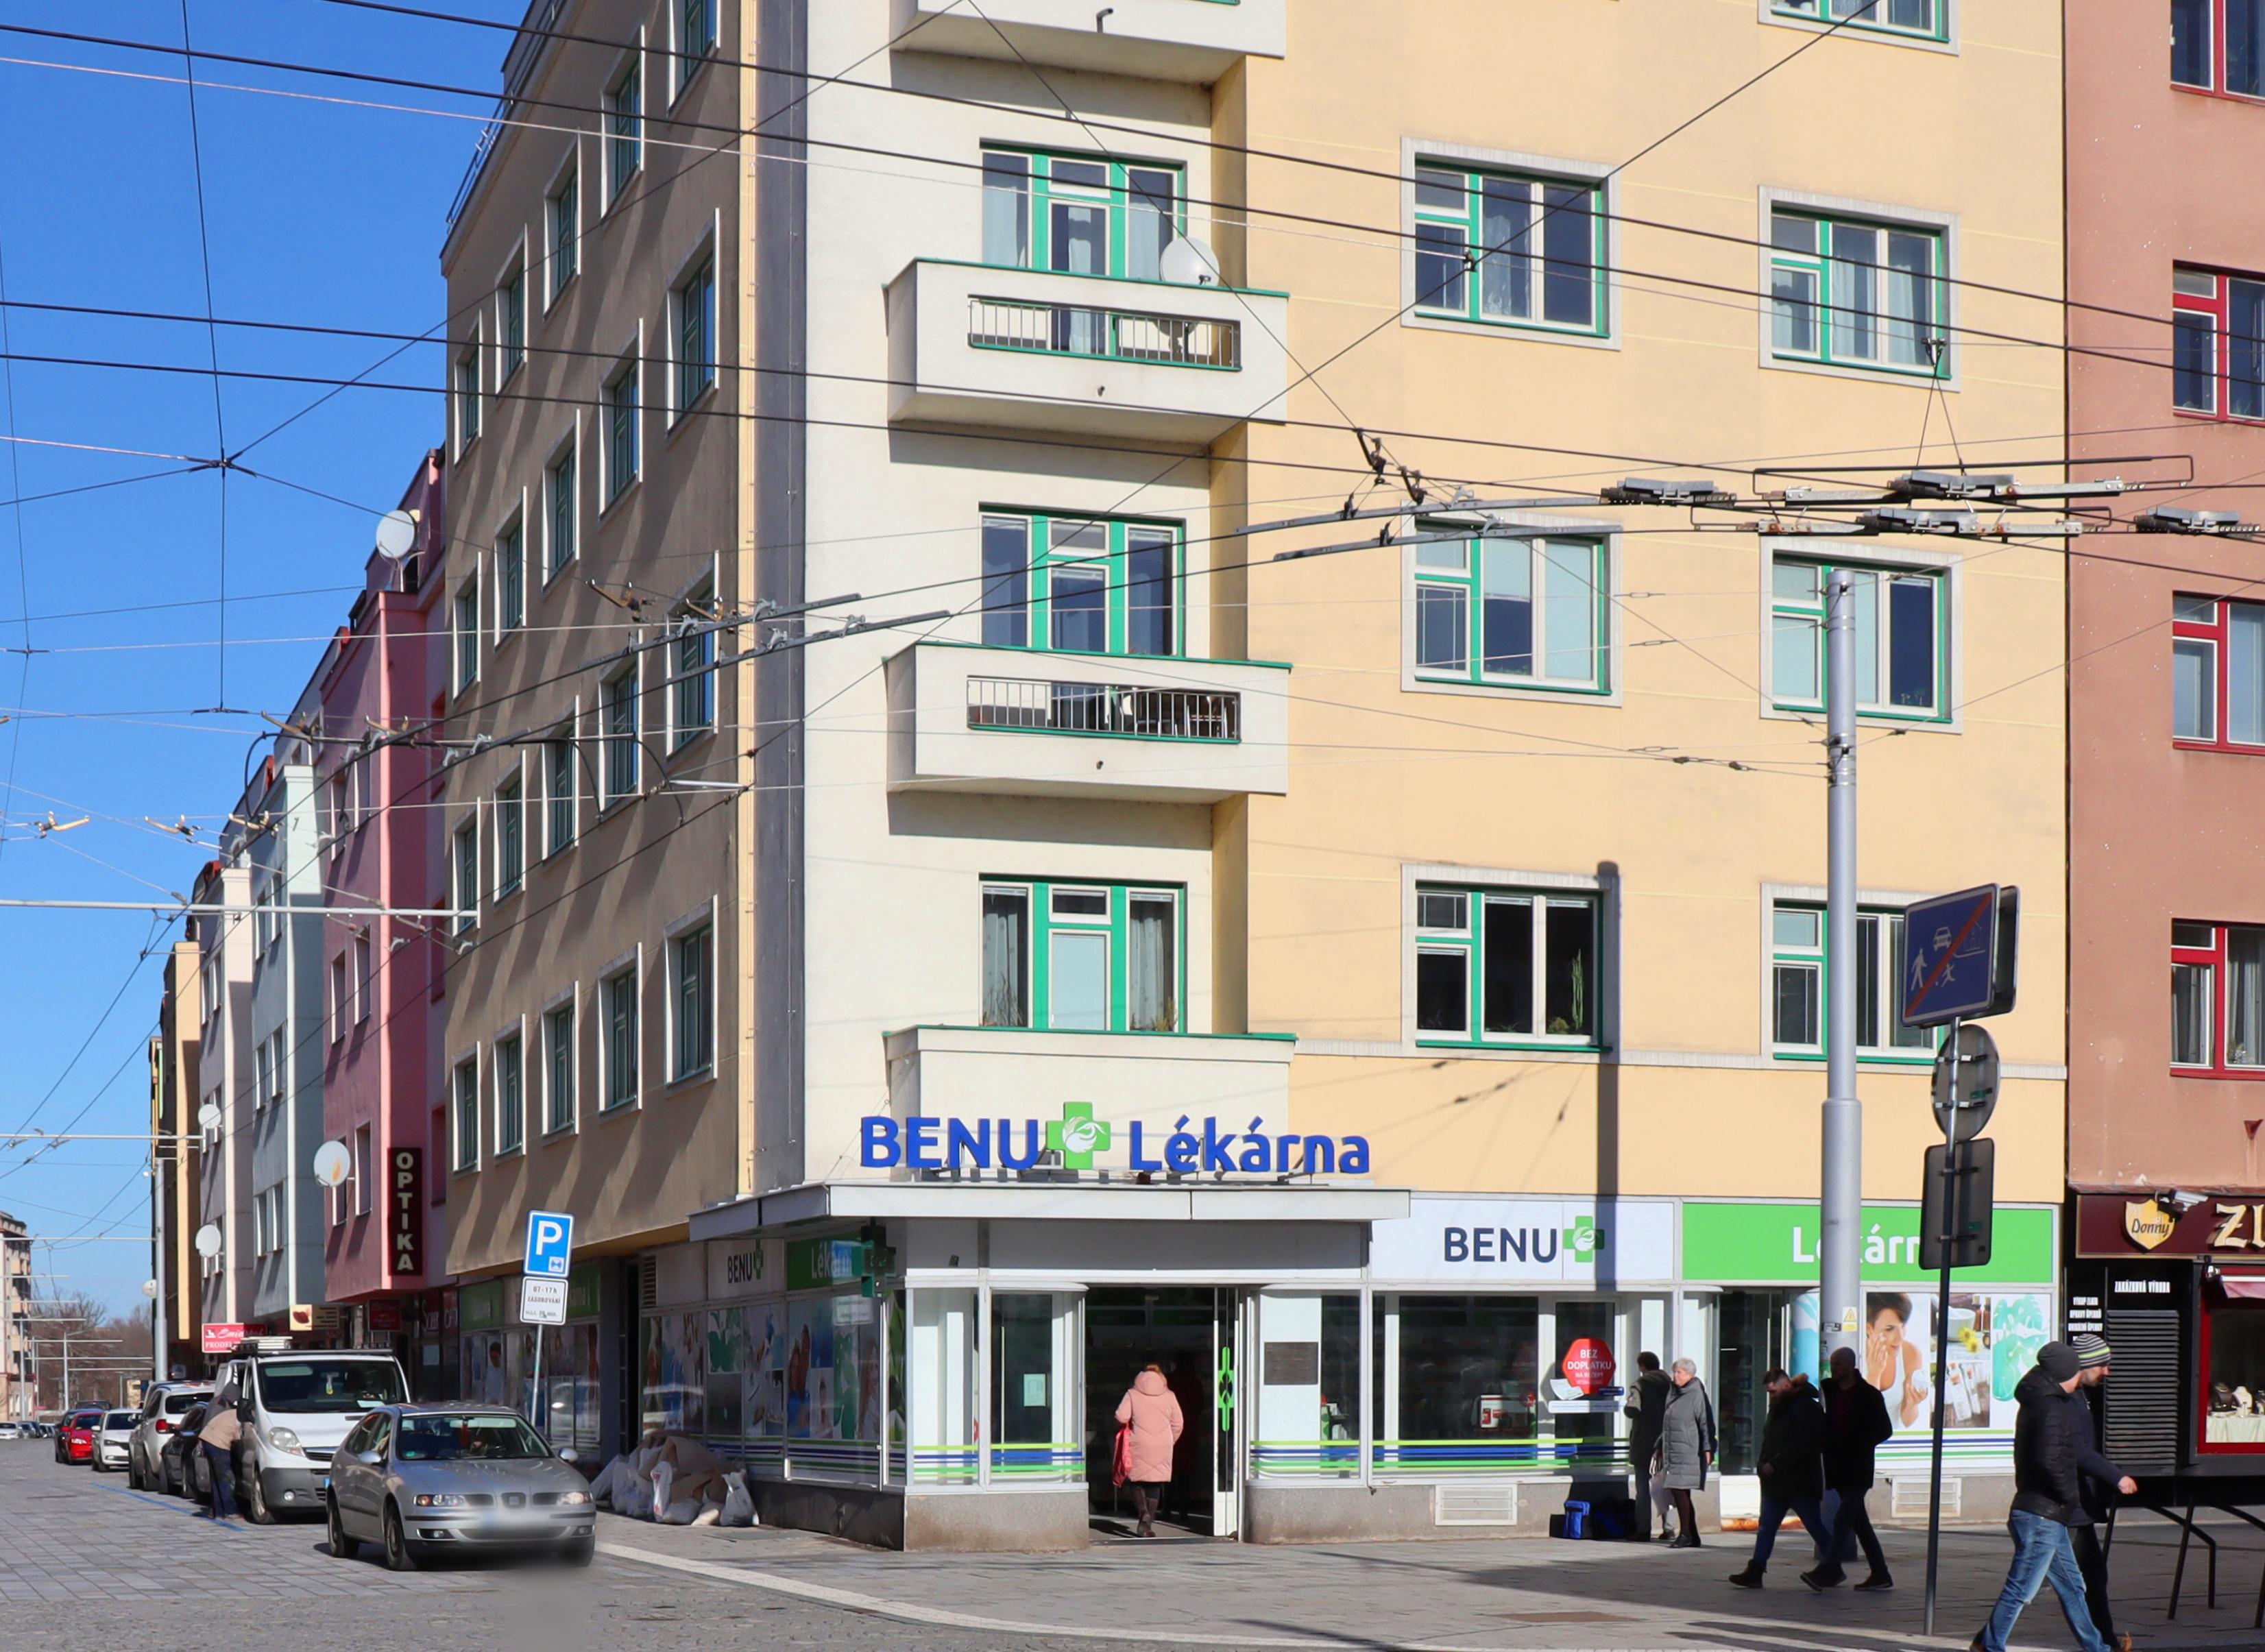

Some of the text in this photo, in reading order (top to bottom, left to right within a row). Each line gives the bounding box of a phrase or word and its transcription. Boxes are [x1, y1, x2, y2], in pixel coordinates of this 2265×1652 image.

[860, 1114, 1370, 1174] BENU Lékárna
[396, 1152, 414, 1271] OPTIKA
[2131, 1217, 2170, 1236] Donny
[535, 1220, 563, 1256] P
[1444, 1226, 1558, 1263] BENU
[727, 1252, 753, 1283] BENU
[1567, 1361, 1612, 1370] DOPLATKU
[1580, 1349, 1598, 1359] BEZ
